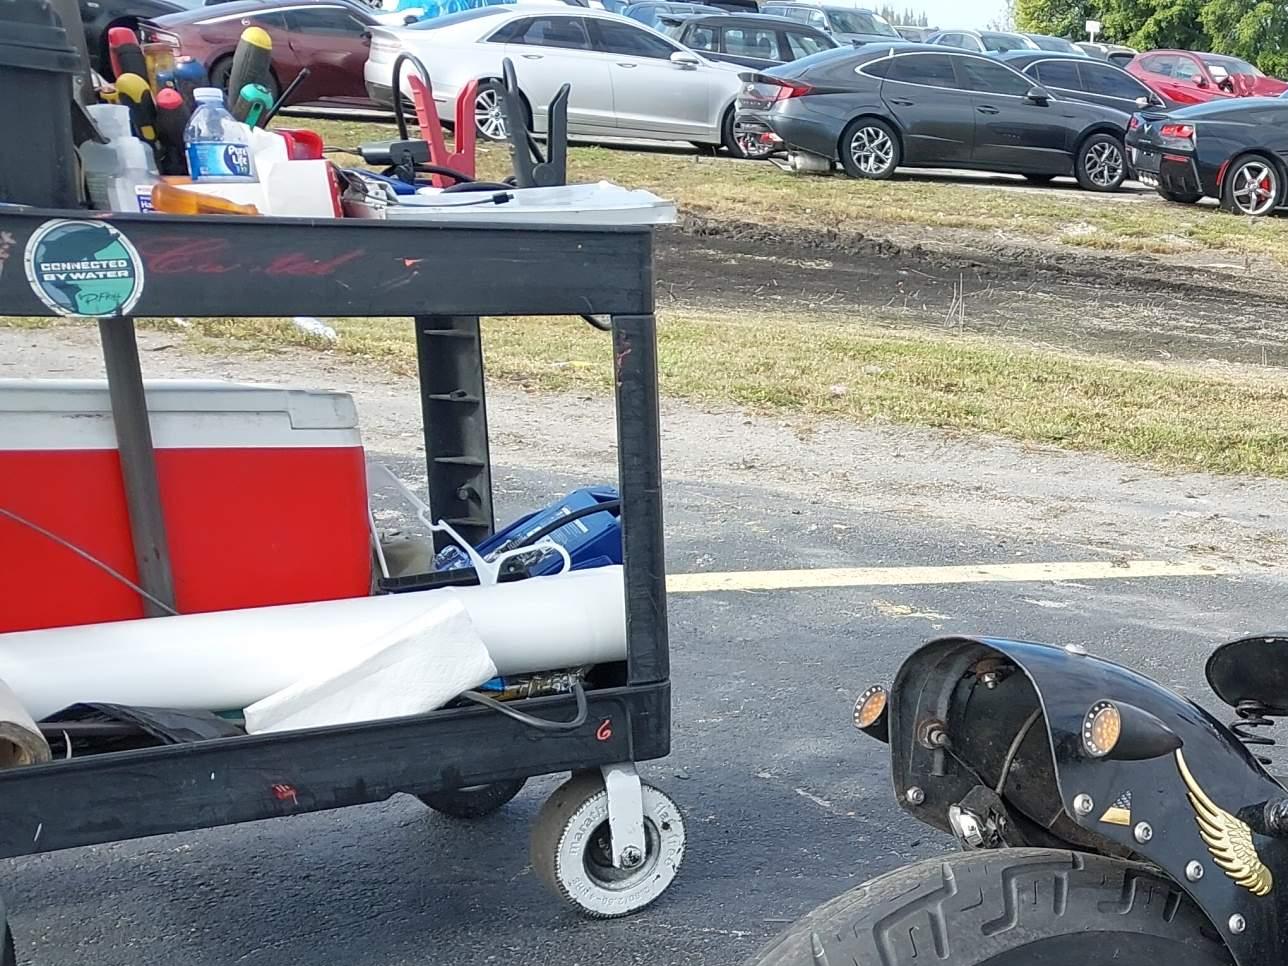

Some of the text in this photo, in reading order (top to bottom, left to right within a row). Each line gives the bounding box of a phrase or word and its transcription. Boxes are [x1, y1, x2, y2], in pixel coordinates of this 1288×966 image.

[40, 260, 128, 271] CONNECTED
[43, 270, 129, 281] BY WATER
